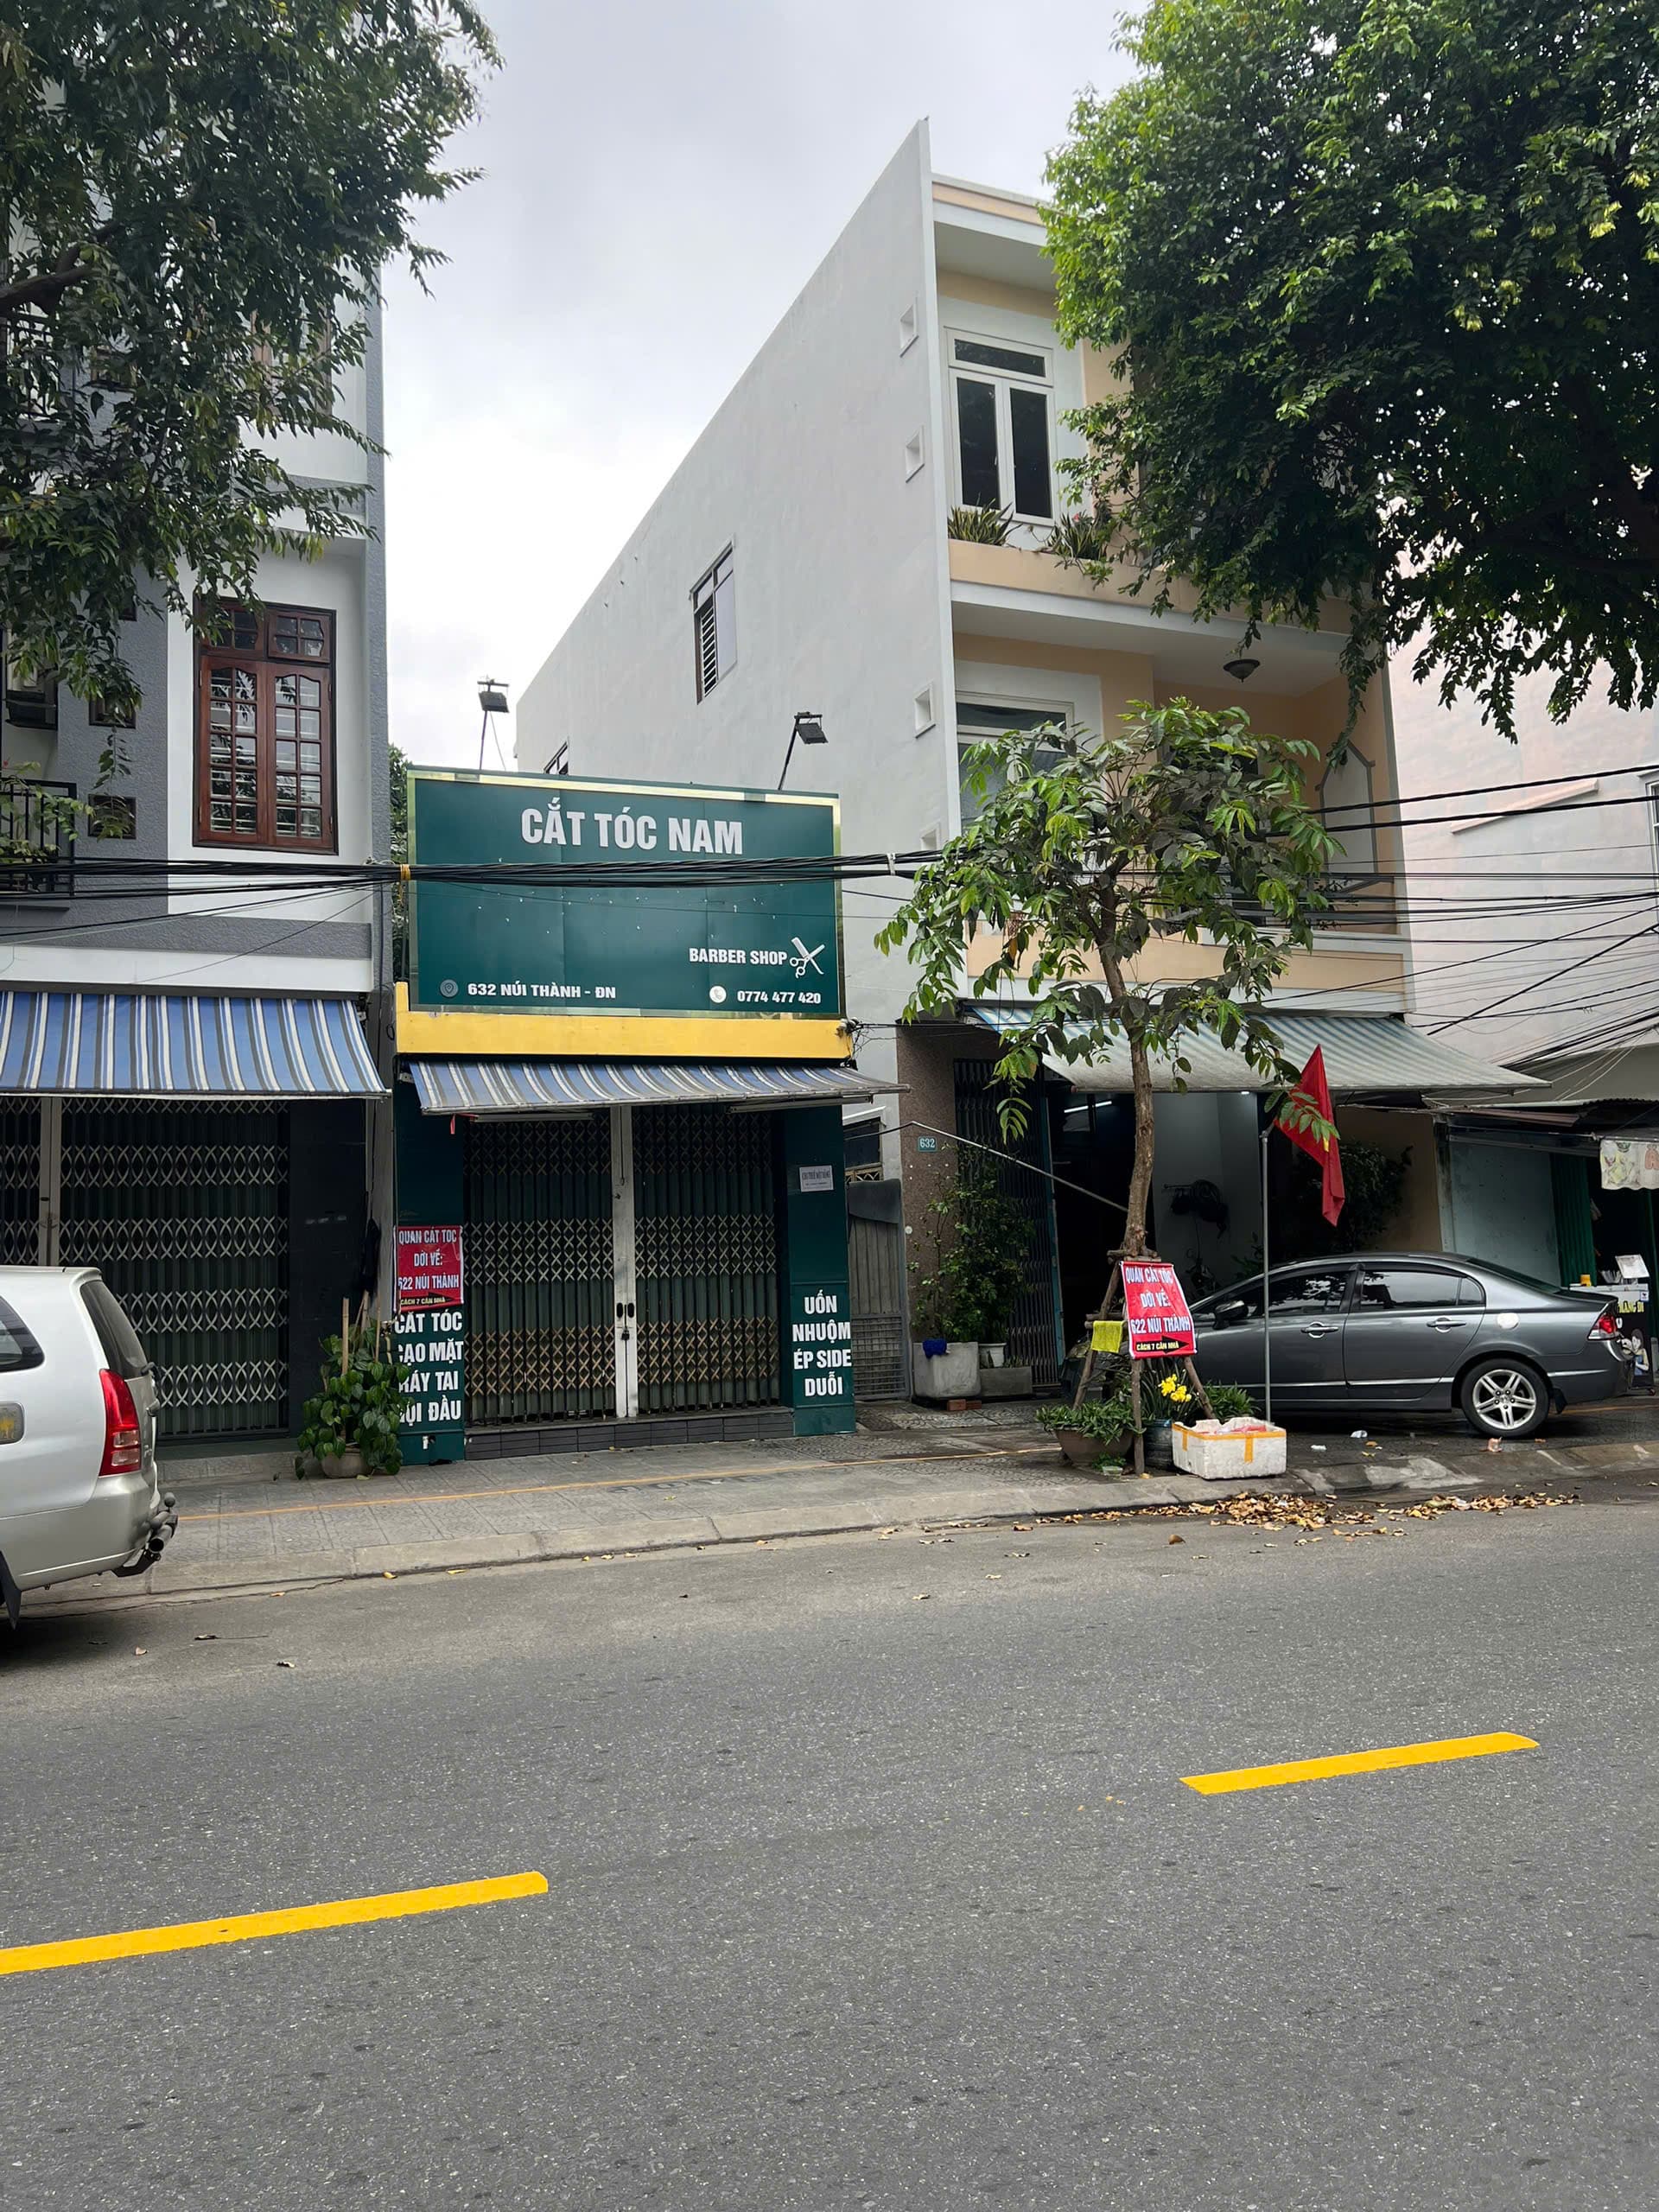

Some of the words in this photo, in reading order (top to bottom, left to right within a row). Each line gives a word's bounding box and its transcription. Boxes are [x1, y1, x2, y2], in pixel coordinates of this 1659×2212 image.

[521, 797, 585, 845] CẮT
[594, 806, 657, 850] TÓC
[668, 817, 743, 855] NAM
[689, 948, 746, 963] BARBER
[750, 950, 787, 965] SHOP
[467, 983, 497, 996] 632
[500, 981, 527, 996] NÚI
[531, 982, 581, 998] THÀNH
[594, 986, 616, 999] ĐN
[737, 990, 768, 1002] 0774
[772, 992, 795, 1003] 477
[798, 993, 821, 1004] 420
[919, 1138, 936, 1148] 632
[415, 1273, 429, 1289] NÚI
[432, 1272, 460, 1288] THÀNH
[804, 1289, 837, 1314] UỐN
[431, 1309, 462, 1332] TÓC
[792, 1319, 851, 1344] NHUỘM
[1130, 1319, 1147, 1334] 622
[1147, 1314, 1162, 1333] NÚI
[1162, 1313, 1191, 1332] THÀNH
[429, 1338, 464, 1363] MẶT
[793, 1348, 814, 1370] ÉP
[817, 1349, 852, 1369] SIDE
[435, 1370, 459, 1391] TAI
[804, 1371, 843, 1396] DUỖI
[428, 1395, 461, 1422] ĐẦU
